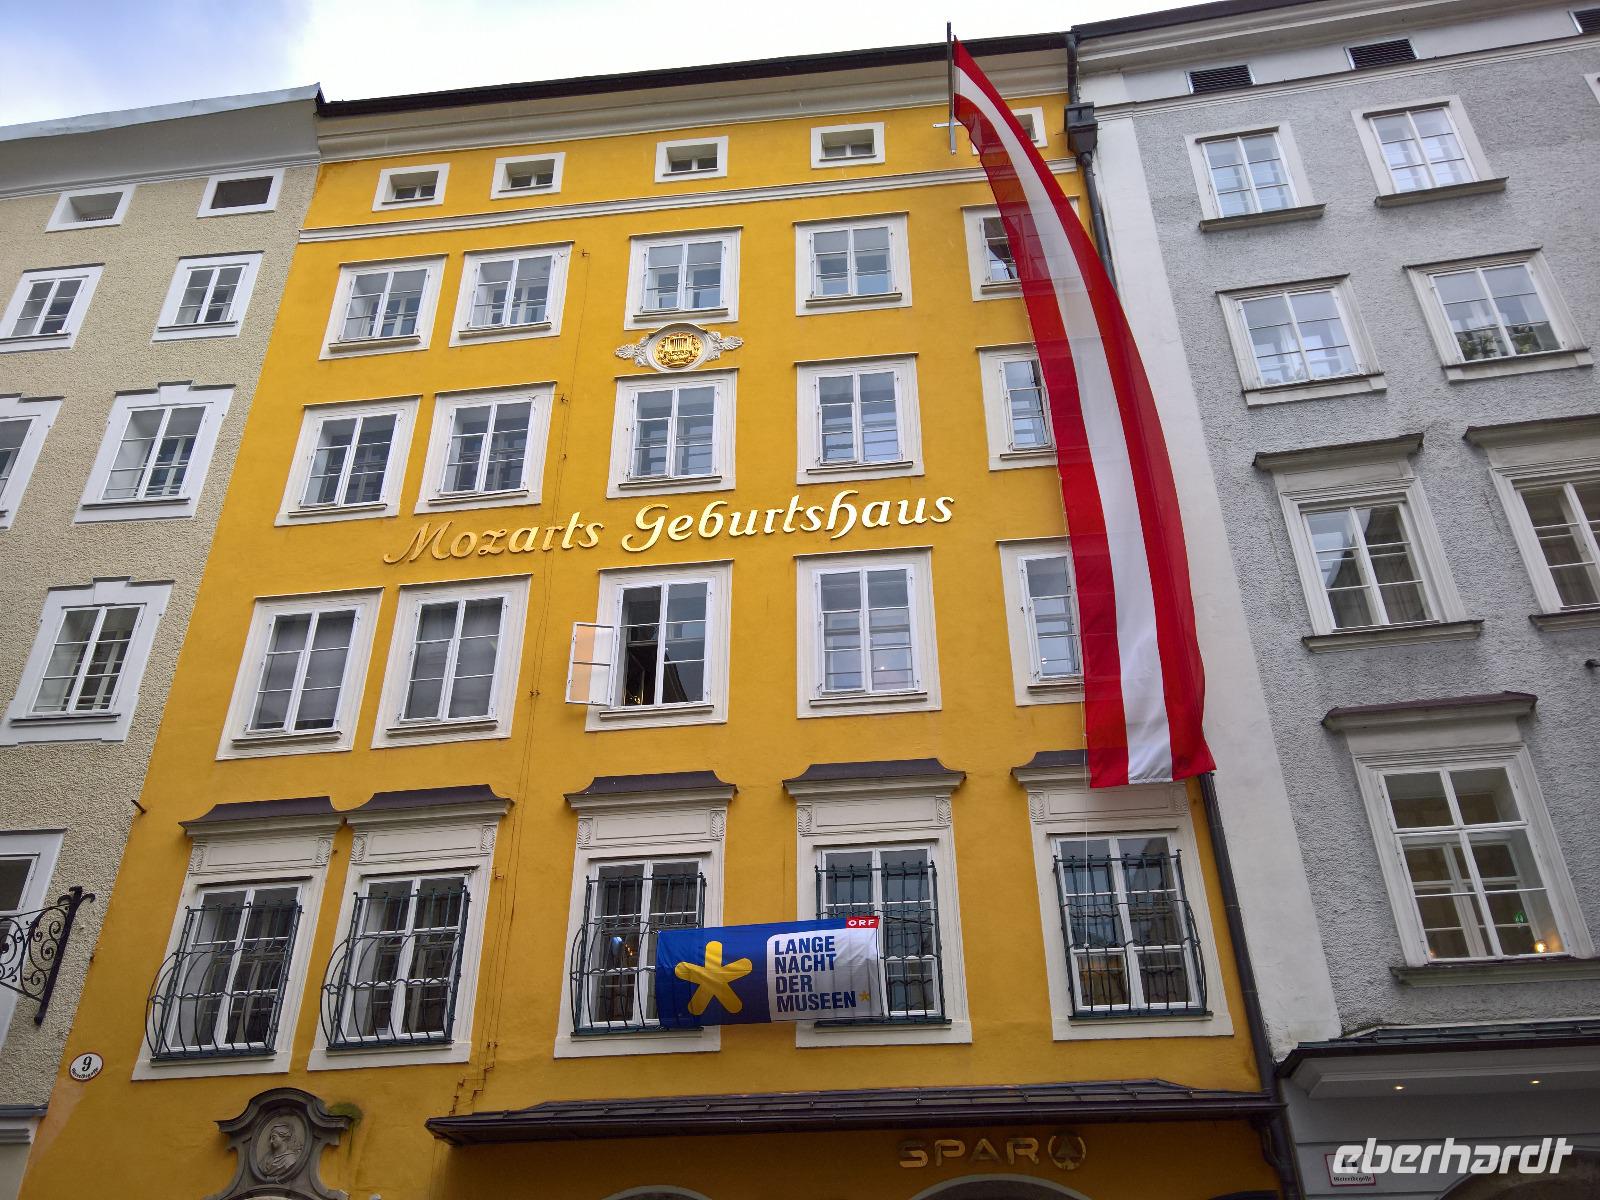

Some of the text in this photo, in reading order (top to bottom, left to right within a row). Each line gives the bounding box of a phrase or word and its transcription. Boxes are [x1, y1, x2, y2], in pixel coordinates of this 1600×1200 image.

[383, 490, 955, 565] Mozarts Geburtshaus
[848, 919, 875, 927] ORF
[775, 936, 835, 955] LANGE
[775, 954, 836, 974] NACHT
[776, 975, 813, 993] DER
[777, 991, 856, 1012] MUSEEN
[82, 1056, 92, 1071] 9
[899, 1138, 1039, 1168] SPAR
